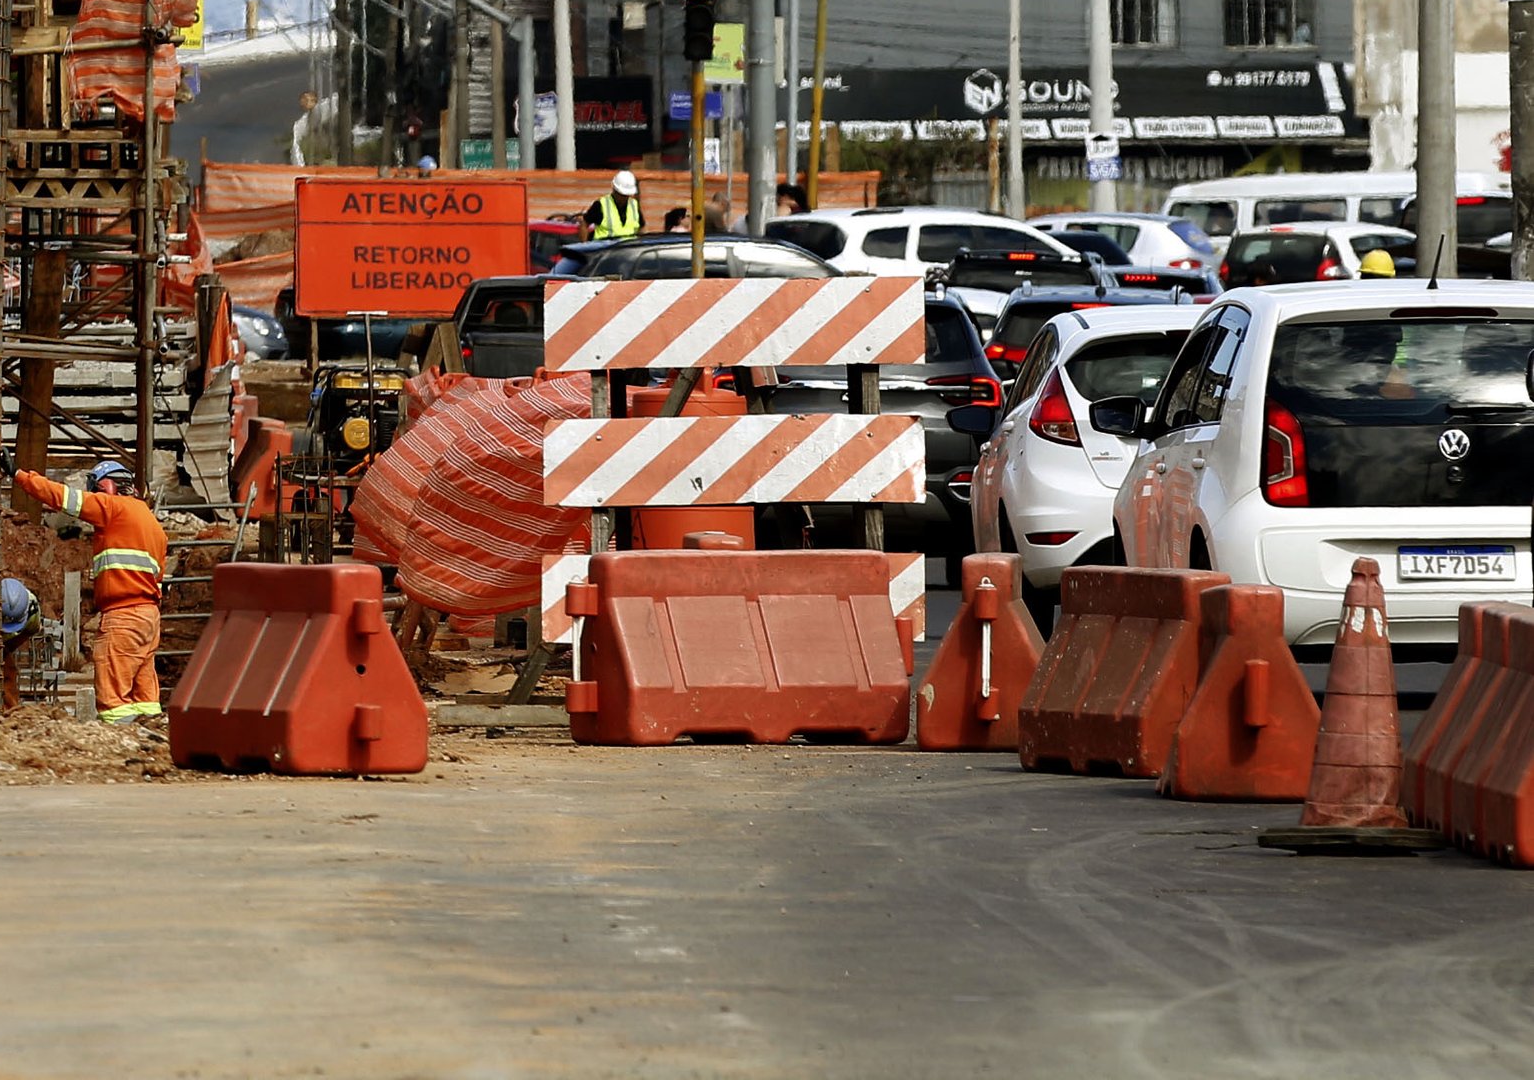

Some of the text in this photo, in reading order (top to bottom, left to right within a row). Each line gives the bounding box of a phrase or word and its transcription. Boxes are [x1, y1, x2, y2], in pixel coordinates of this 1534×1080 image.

[341, 188, 484, 220] ATENÇÃO
[353, 246, 471, 265] RETORNO
[351, 271, 475, 290] LIBERADO
[1410, 556, 1504, 575] IXF7D54
